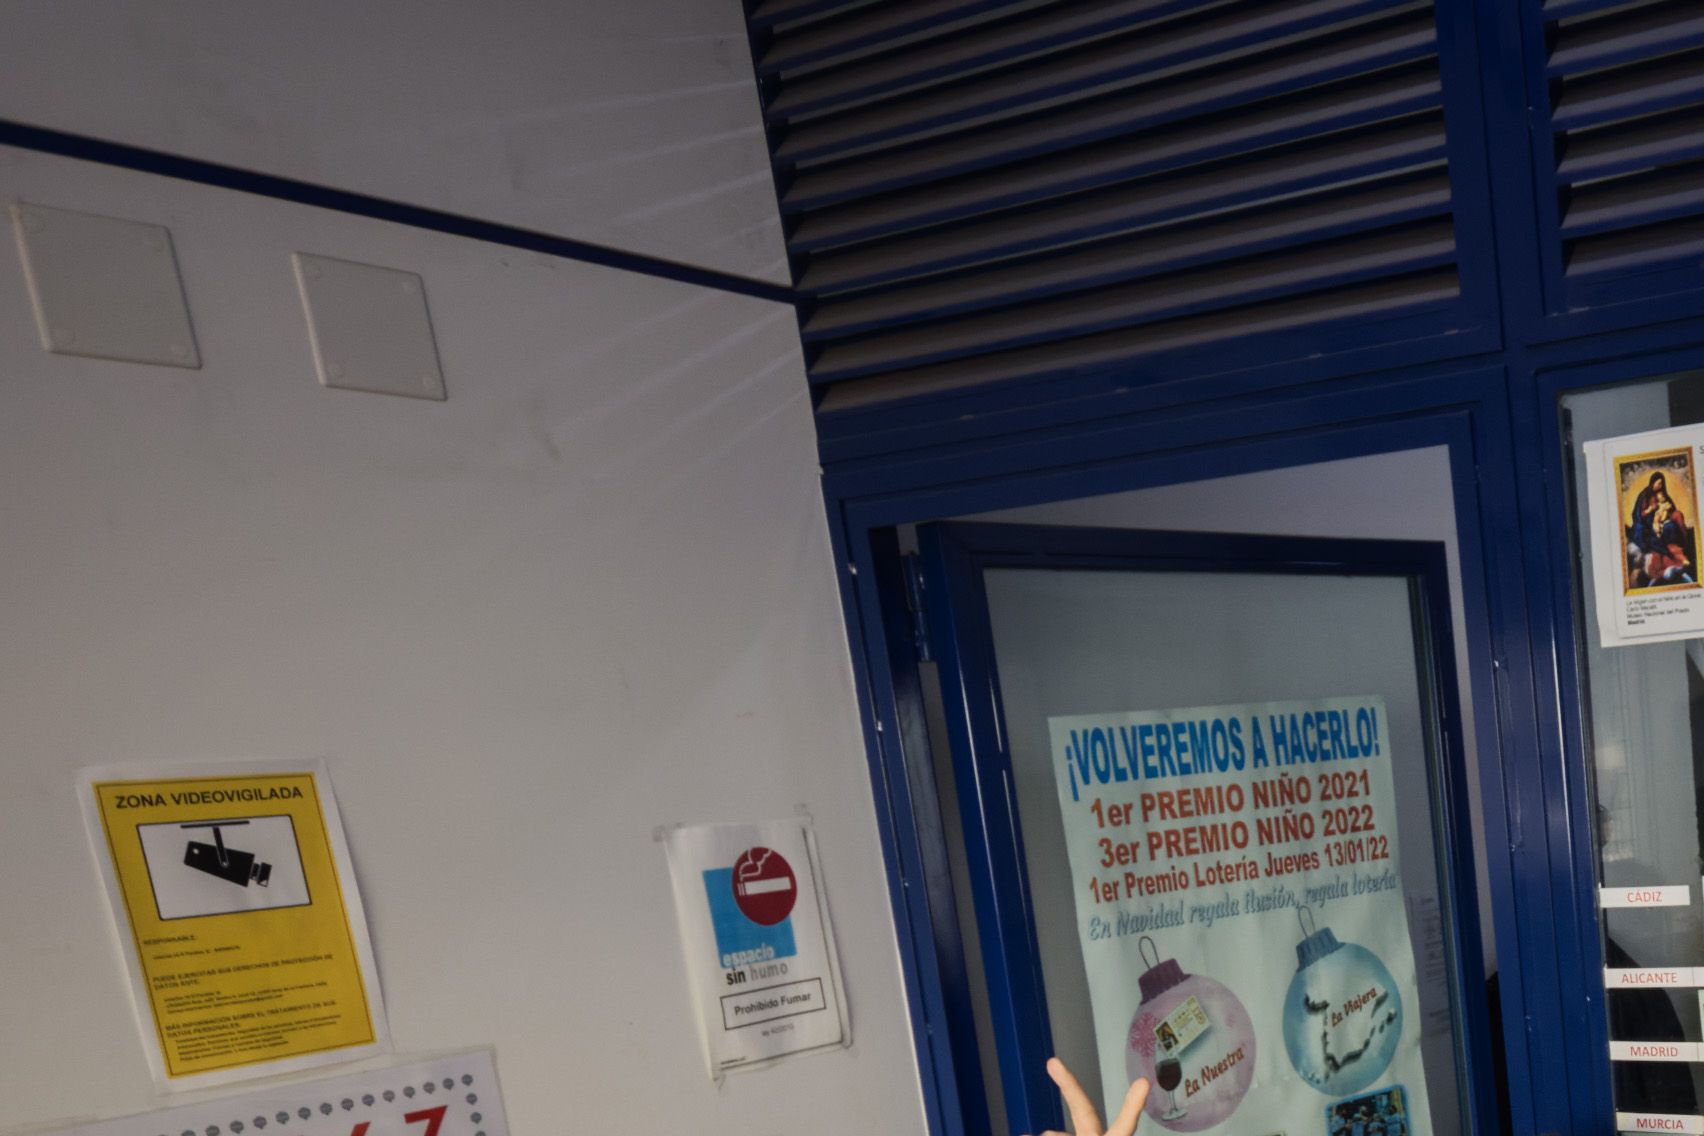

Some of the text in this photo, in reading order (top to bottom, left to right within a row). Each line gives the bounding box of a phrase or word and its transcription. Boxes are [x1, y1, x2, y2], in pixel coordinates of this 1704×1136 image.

[1066, 707, 1380, 801] ¡VOLVEREMOS A HACERLO!
[115, 786, 303, 809] ZONA VIDEOVIGILADA
[1090, 769, 1371, 829] 1er PREMIO NIÑO 2021
[1098, 804, 1376, 868] 3er PREMIO NIÑO 2022
[1090, 835, 1389, 904] 1er Premio Lotería Jueves 13/01/22
[1627, 889, 1662, 903] CÁDIZ
[726, 962, 788, 986] sin humo
[1621, 971, 1678, 984] ALICANTE
[734, 993, 811, 1016] Prohibido Fumar
[1331, 987, 1377, 1028] La Viajera
[1630, 1045, 1678, 1057] MADRID
[1184, 1046, 1245, 1099] La Nuestra
[1637, 1118, 1684, 1129] MURCIA
